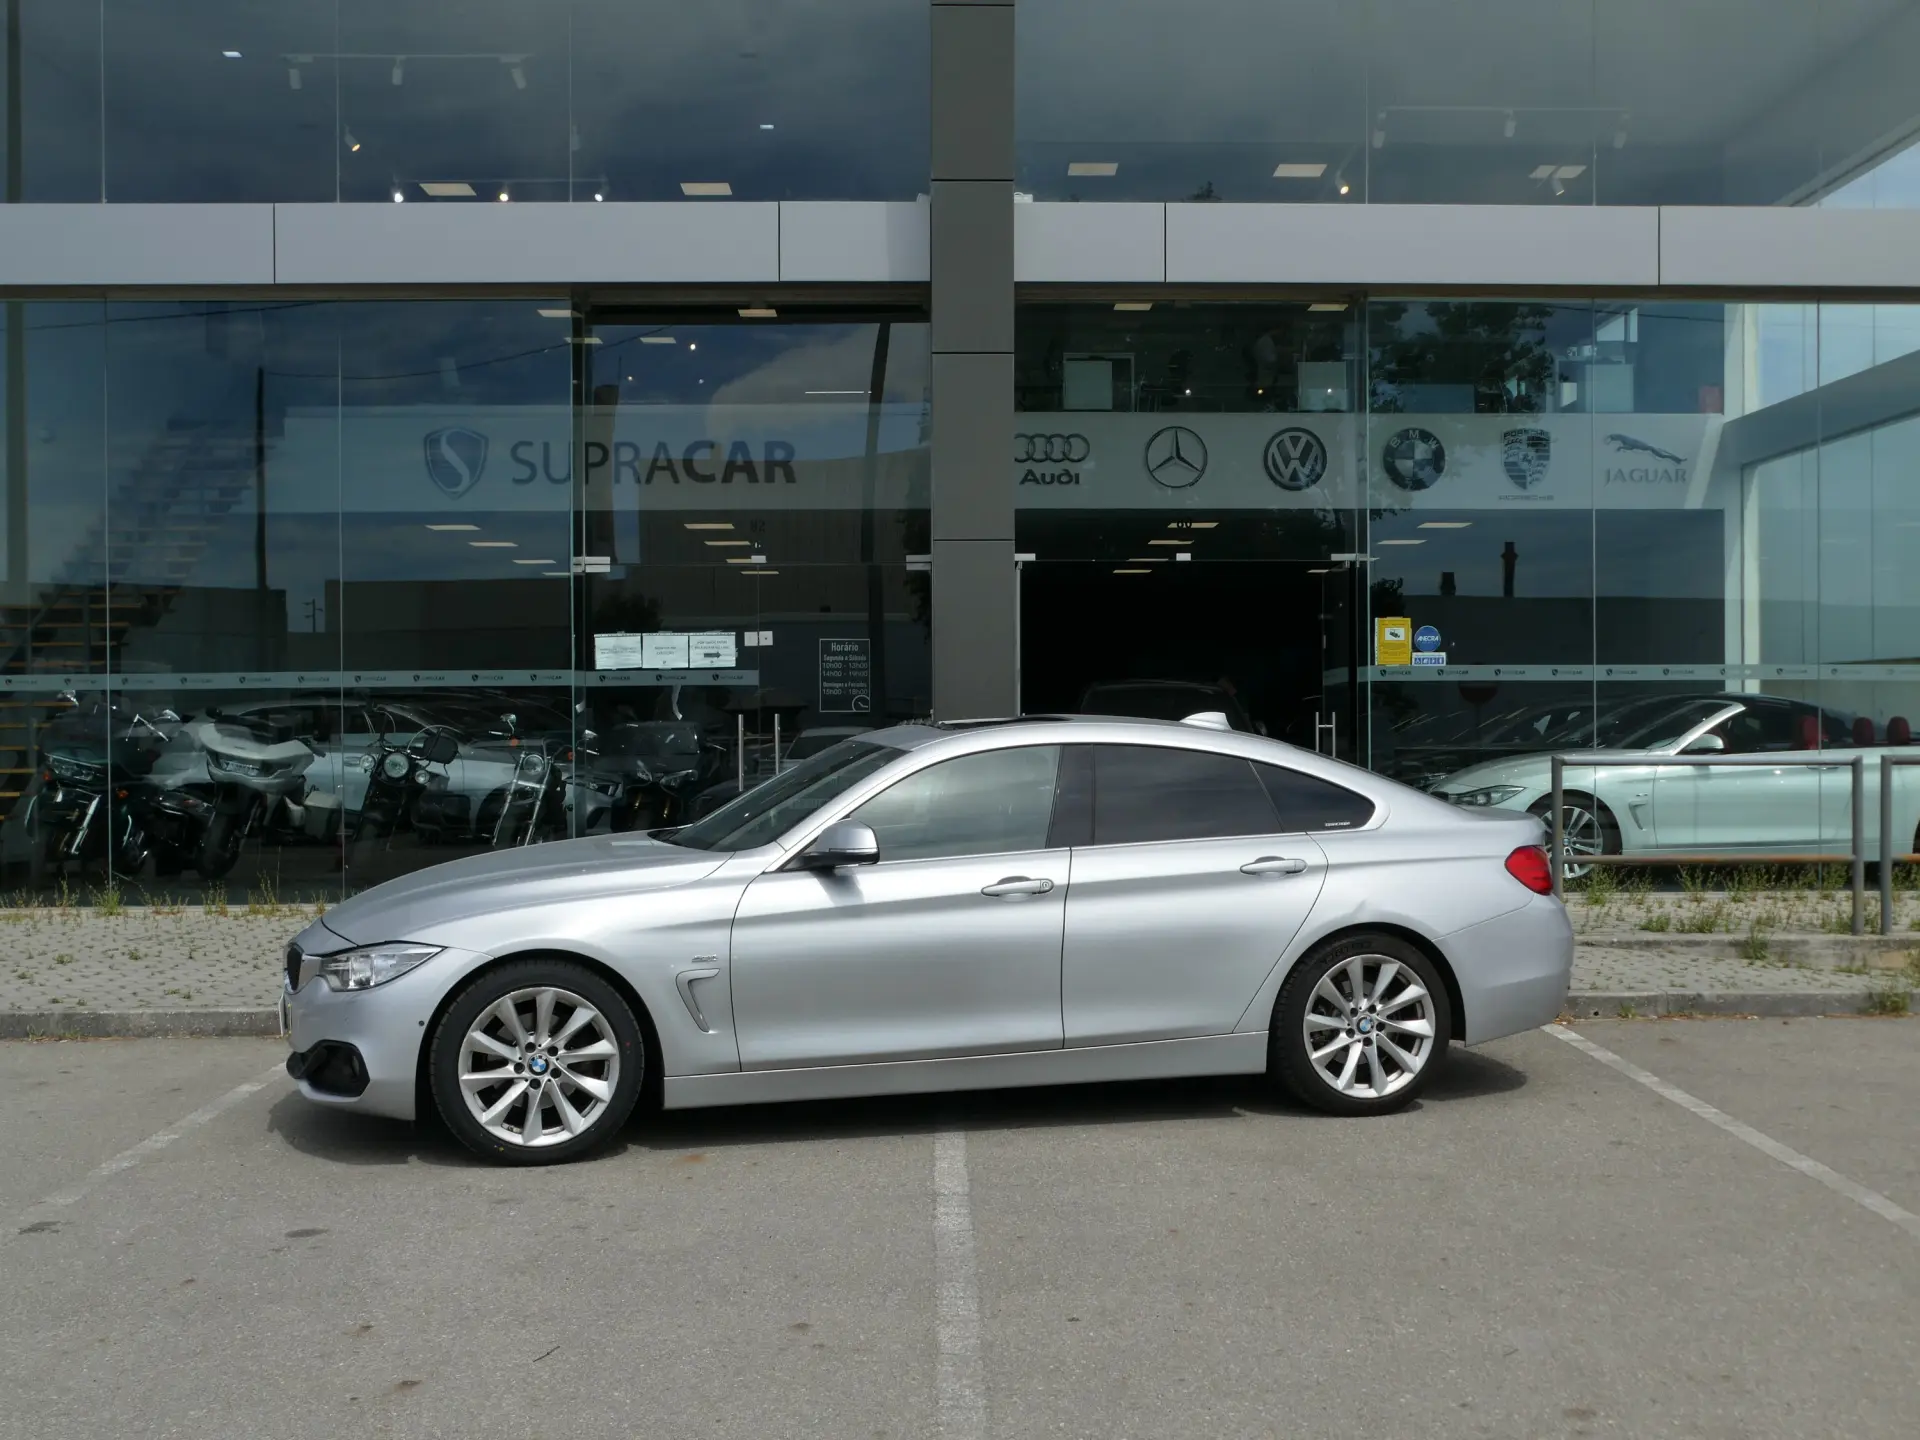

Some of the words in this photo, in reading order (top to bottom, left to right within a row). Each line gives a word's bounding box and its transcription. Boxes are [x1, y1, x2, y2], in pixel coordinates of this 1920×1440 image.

[1390, 429, 1440, 450] BMW
[510, 440, 797, 485] SUPRACAR
[1019, 468, 1080, 485] Audi
[1603, 467, 1687, 487] JAGUAR
[831, 641, 859, 652] Horário
